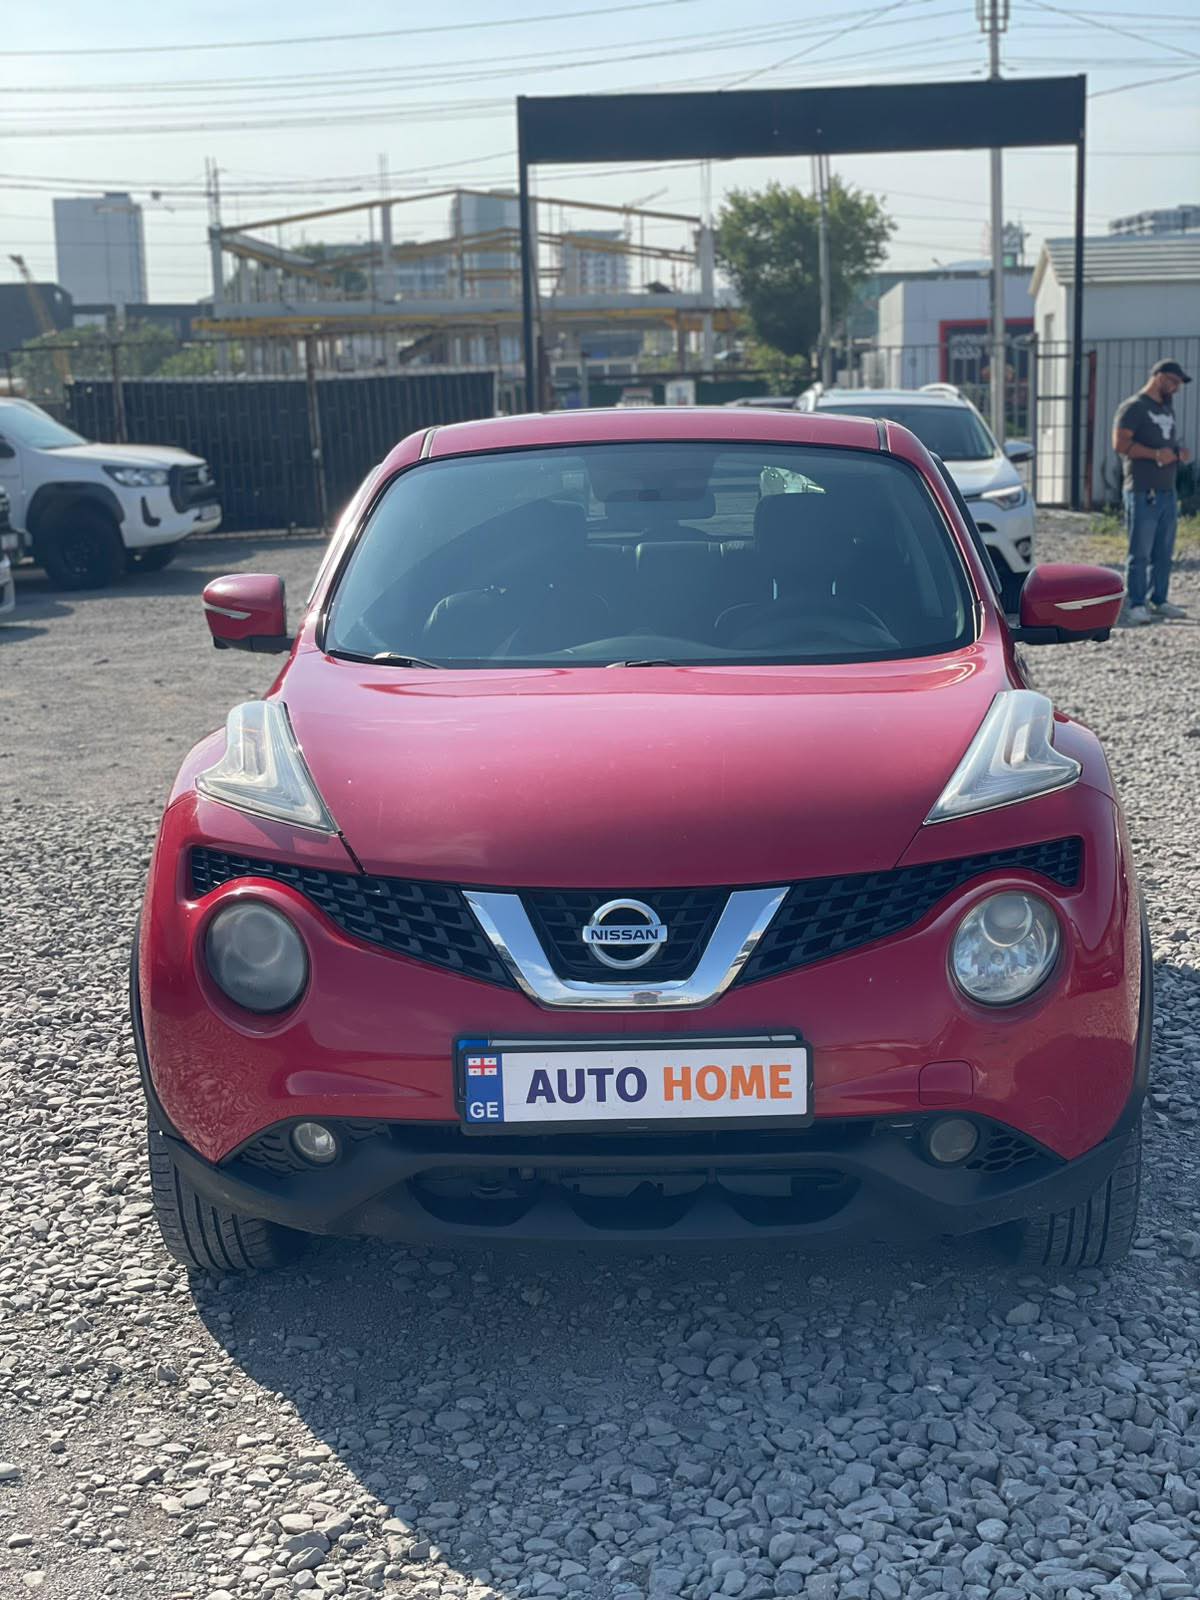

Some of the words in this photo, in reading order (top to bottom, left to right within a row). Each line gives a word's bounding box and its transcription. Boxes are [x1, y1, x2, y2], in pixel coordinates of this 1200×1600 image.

[590, 928, 659, 941] NISSAN
[525, 1066, 648, 1104] AUTO
[663, 1064, 793, 1101] HOME
[469, 1101, 499, 1119] GE
